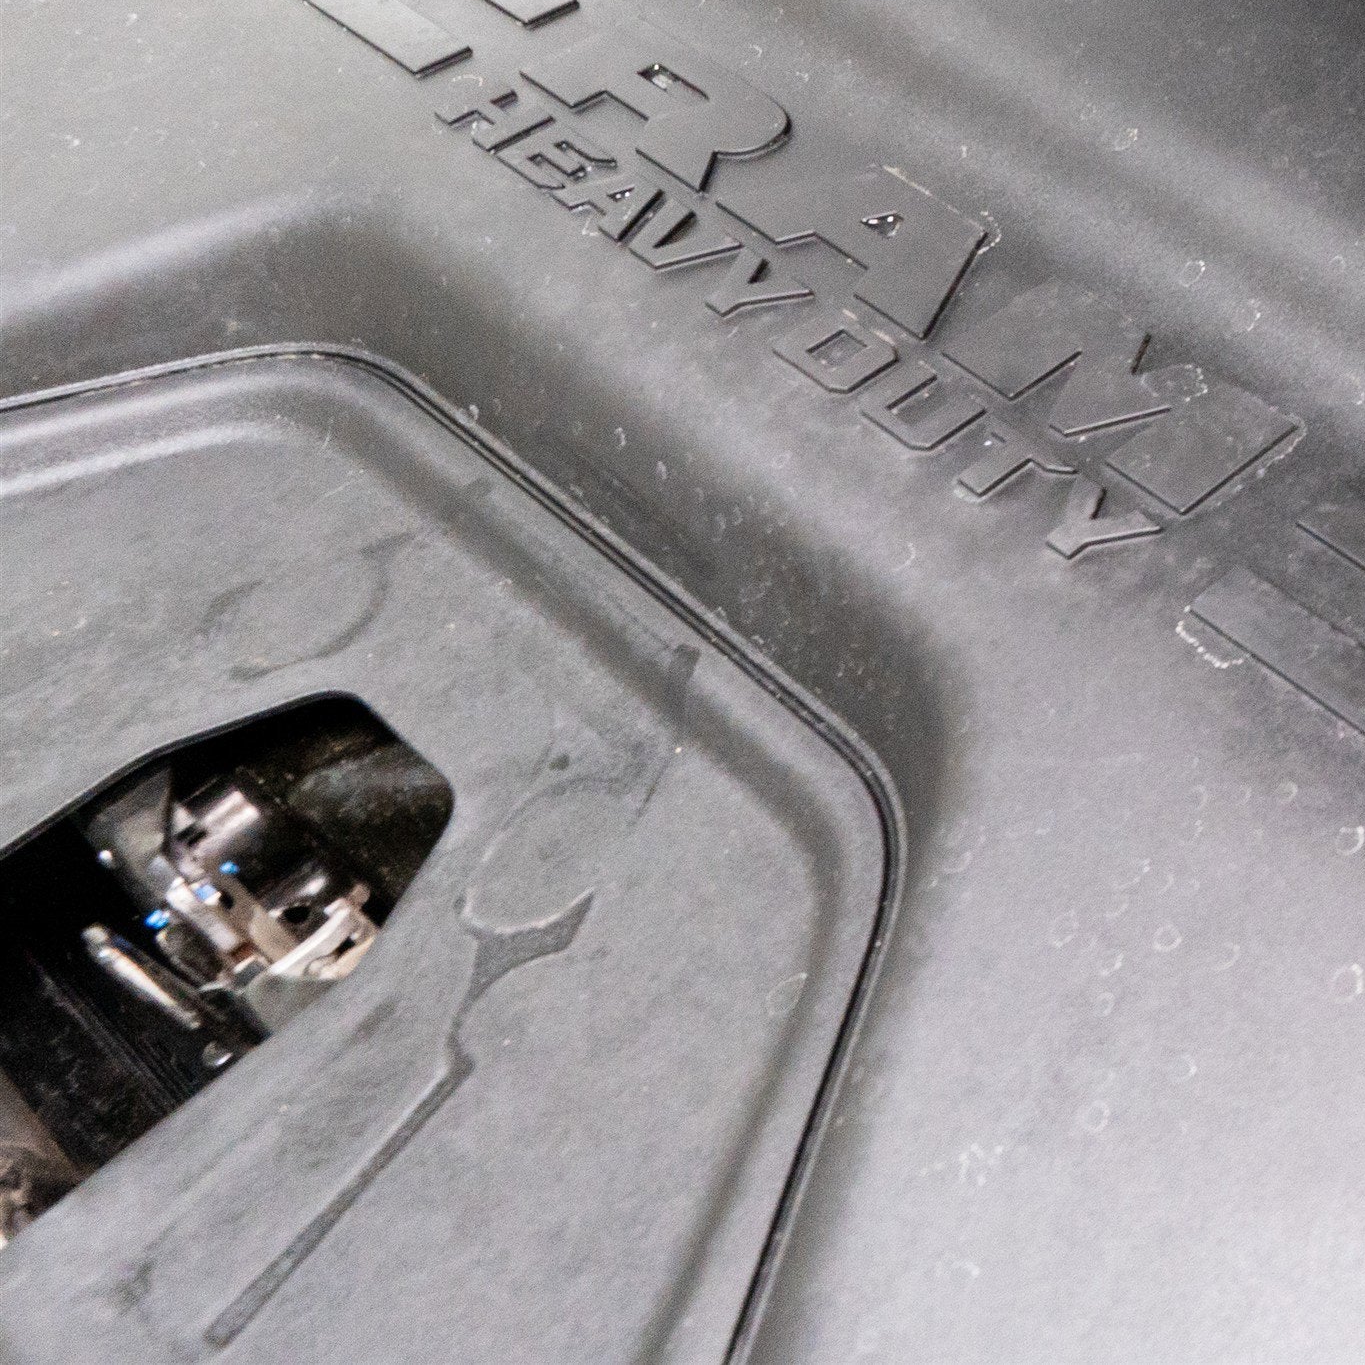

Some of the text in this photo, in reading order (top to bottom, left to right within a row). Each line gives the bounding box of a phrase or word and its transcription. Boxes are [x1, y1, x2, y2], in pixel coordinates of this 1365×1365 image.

[433, 87, 1163, 560] HEAVY DUTY
[519, 23, 1302, 514] RAM
